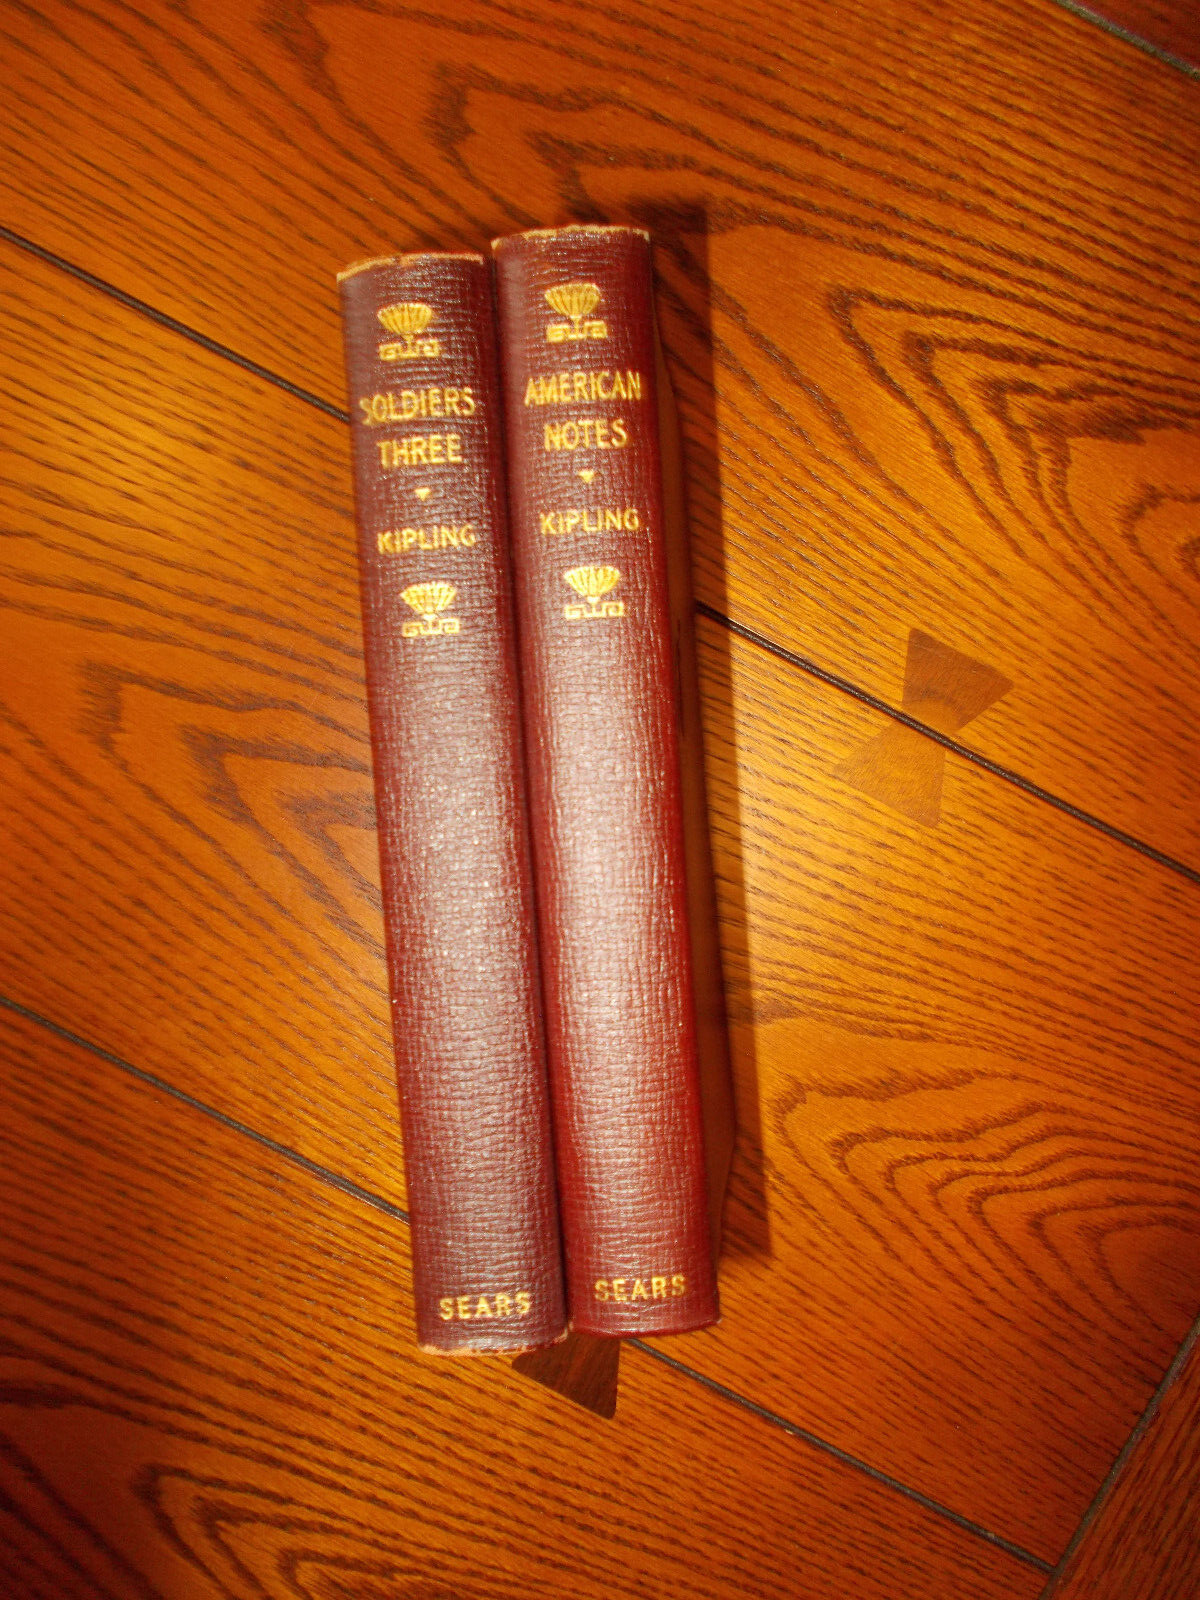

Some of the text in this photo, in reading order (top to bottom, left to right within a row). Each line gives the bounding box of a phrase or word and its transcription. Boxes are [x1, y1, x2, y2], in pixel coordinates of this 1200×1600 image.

[524, 370, 642, 407] AMERICAN
[359, 387, 475, 426] SOLDIERS
[544, 419, 629, 451] NOTES
[376, 433, 463, 469] THREE
[539, 508, 640, 536] KIPLING
[376, 524, 476, 555] KIPLING
[594, 1273, 686, 1302] SEARS
[439, 1292, 532, 1321] SEARS
